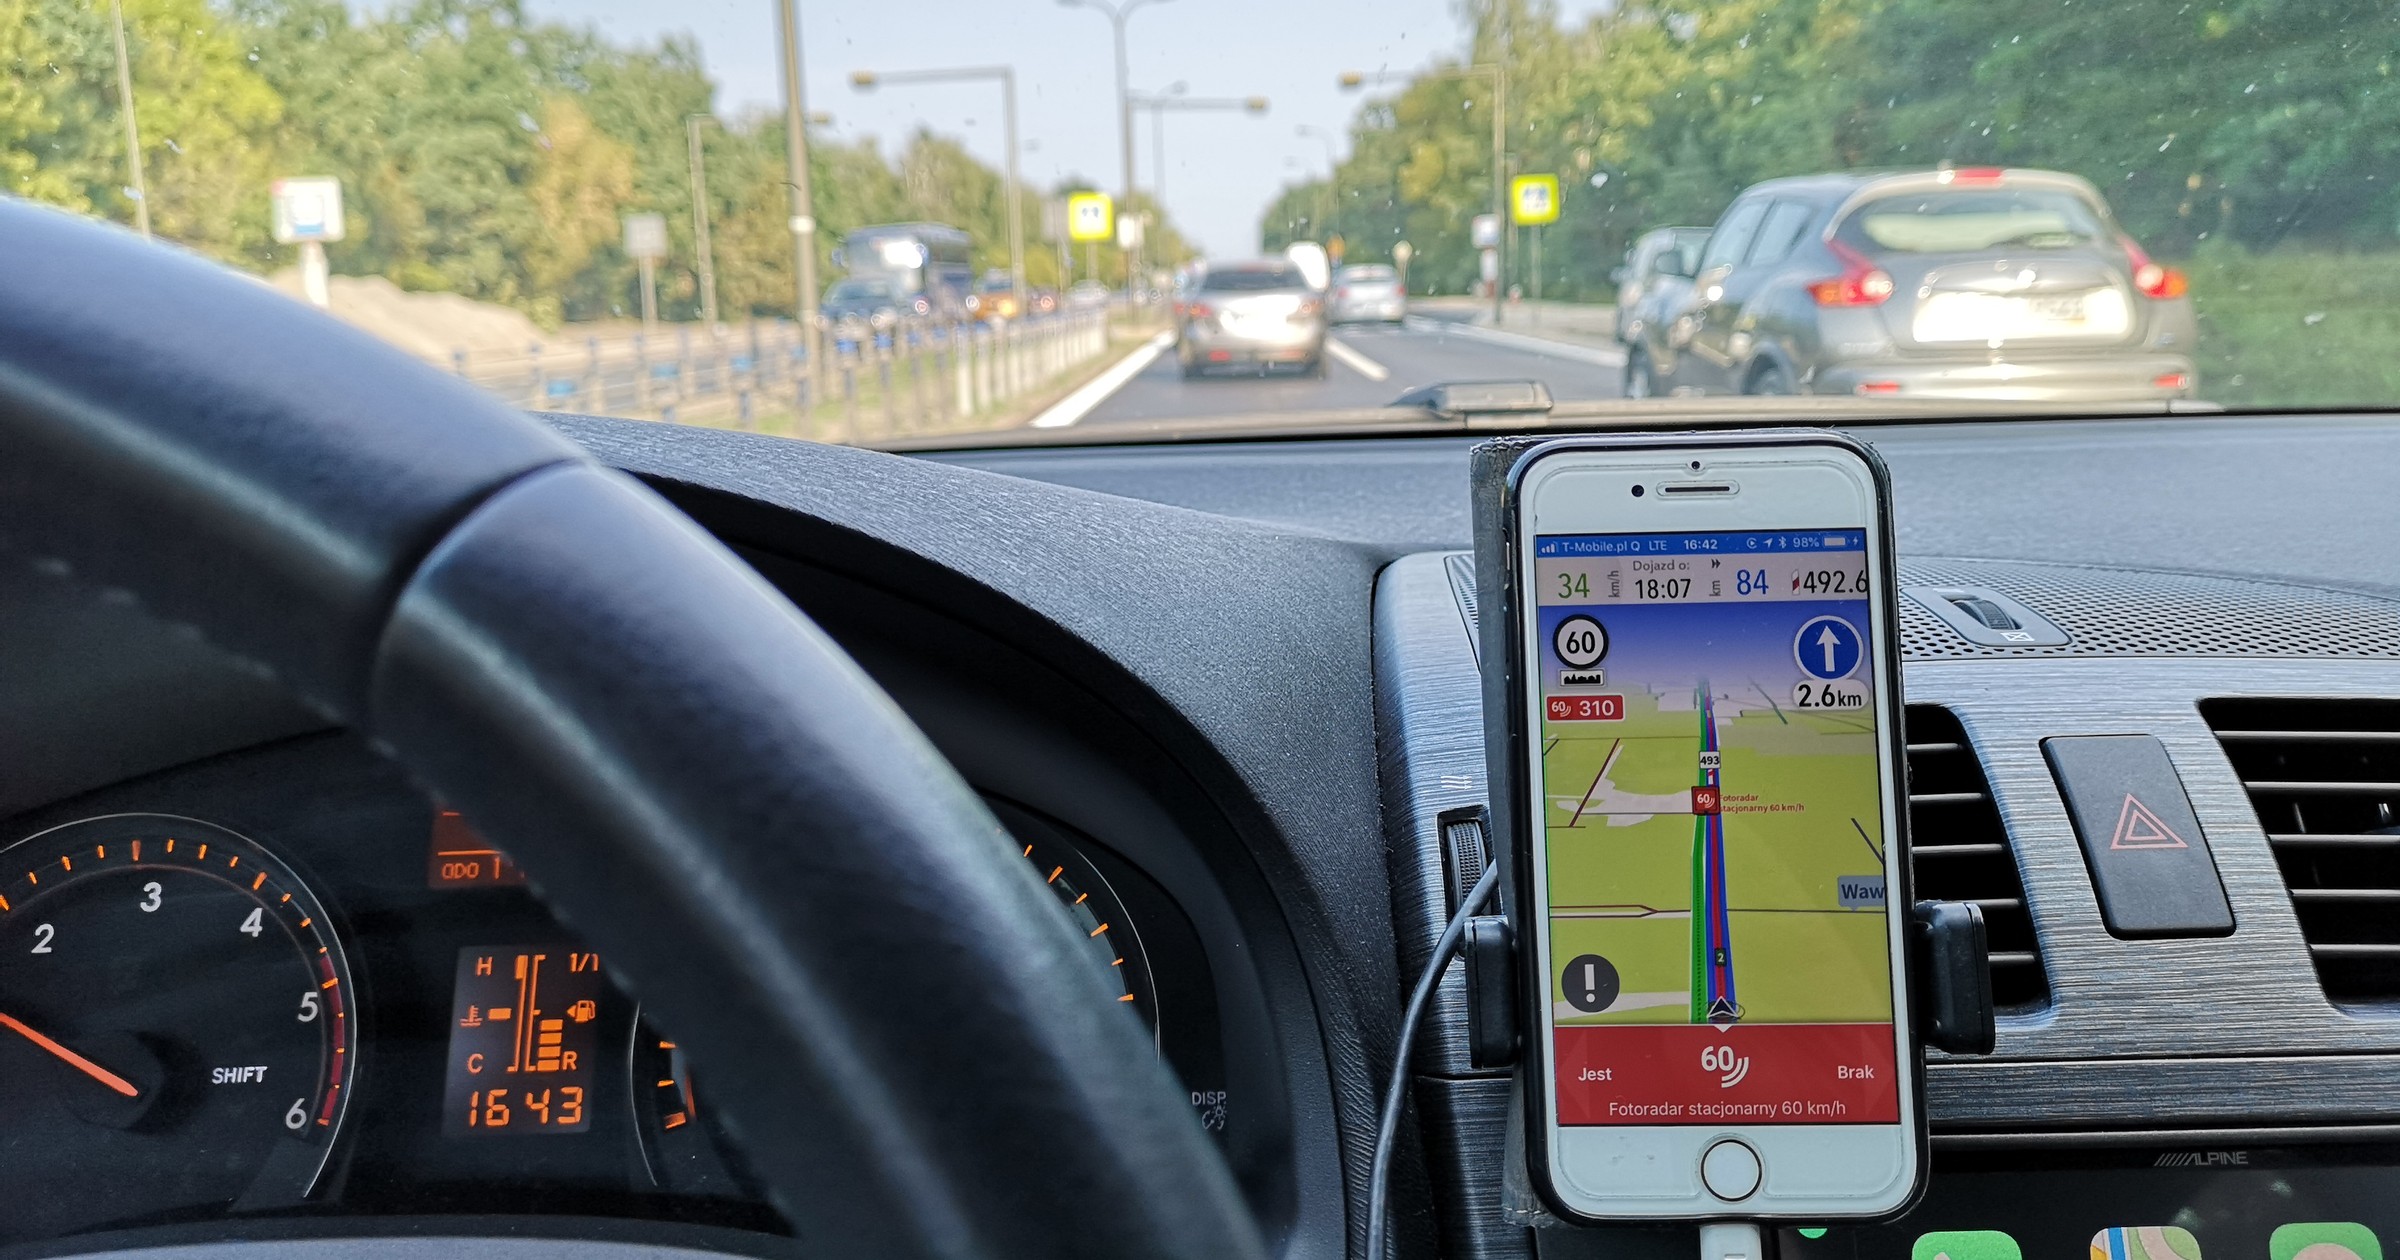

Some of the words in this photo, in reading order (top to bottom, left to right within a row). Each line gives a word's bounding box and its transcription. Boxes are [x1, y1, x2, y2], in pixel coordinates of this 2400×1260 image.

[1562, 541, 1628, 553] T-Mobile.pl
[1649, 540, 1668, 551] LTE
[1683, 539, 1718, 550] 16:42
[1793, 537, 1820, 548] 98%
[1633, 559, 1675, 573] Dojazd
[1677, 561, 1690, 571] o:
[1558, 573, 1591, 599] 34
[1608, 570, 1620, 599] km/h
[1635, 578, 1692, 600] 18:07
[1710, 579, 1722, 597] km
[1736, 568, 1769, 596] 84
[1803, 570, 1867, 595] 492.6
[1566, 630, 1596, 655] 60
[1551, 701, 1566, 714] 60
[1579, 699, 1615, 718] 310
[1700, 755, 1721, 767] 493
[1697, 793, 1711, 805] 60
[1770, 804, 1780, 812] 60
[1781, 803, 1805, 812] km/h
[140, 881, 164, 913] 3
[240, 906, 264, 938] 4
[31, 923, 56, 954] 2
[475, 956, 493, 976] H
[1717, 952, 1725, 963] 2
[297, 991, 320, 1024] 5
[467, 1053, 484, 1074] C
[562, 1050, 579, 1071] R
[1701, 1046, 1735, 1072] 60
[211, 1065, 268, 1085] SHIFT
[1578, 1067, 1612, 1082] Jest
[1838, 1065, 1875, 1080] Brak
[285, 1098, 307, 1130] 6
[1609, 1101, 1684, 1117] Fotoradar
[1688, 1101, 1778, 1120] stacjonarny
[1781, 1101, 1803, 1116] 60
[1807, 1100, 1847, 1117] km/h
